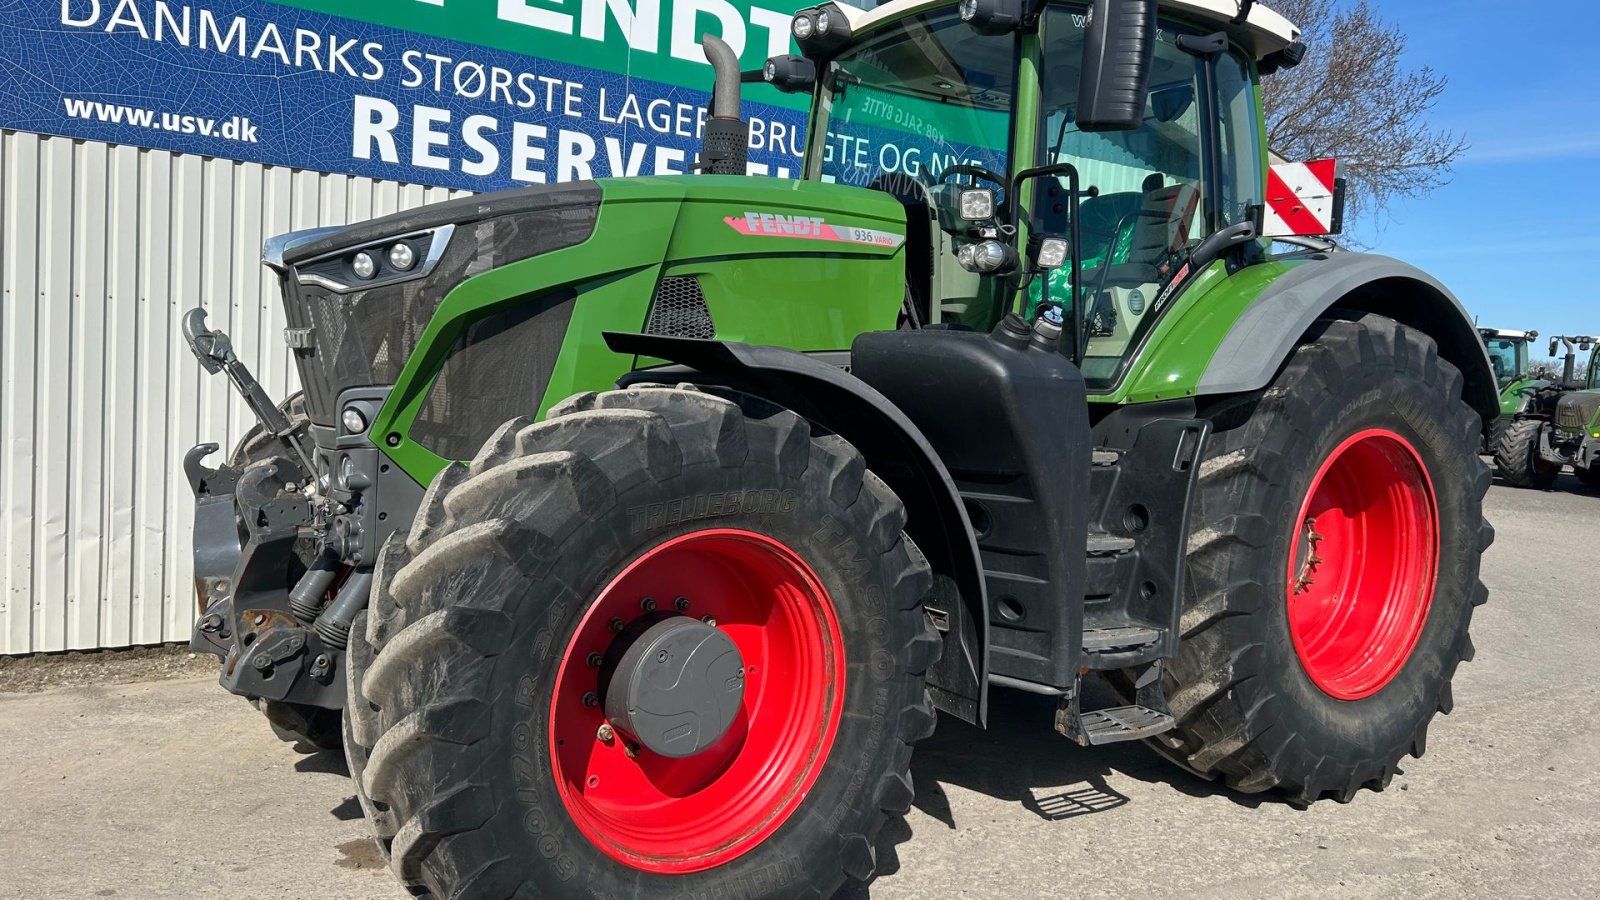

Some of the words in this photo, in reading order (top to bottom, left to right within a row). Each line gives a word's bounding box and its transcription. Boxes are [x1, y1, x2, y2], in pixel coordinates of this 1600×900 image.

[60, 0, 385, 81] DANMARKS
[401, 50, 583, 118] STØRSTE
[879, 143, 921, 177] OG
[63, 98, 258, 143] www.usv.dk
[744, 211, 825, 236] FENDT
[854, 229, 873, 242] 936
[874, 236, 893, 246] VARIO
[626, 488, 799, 537] TRELLEBORG
